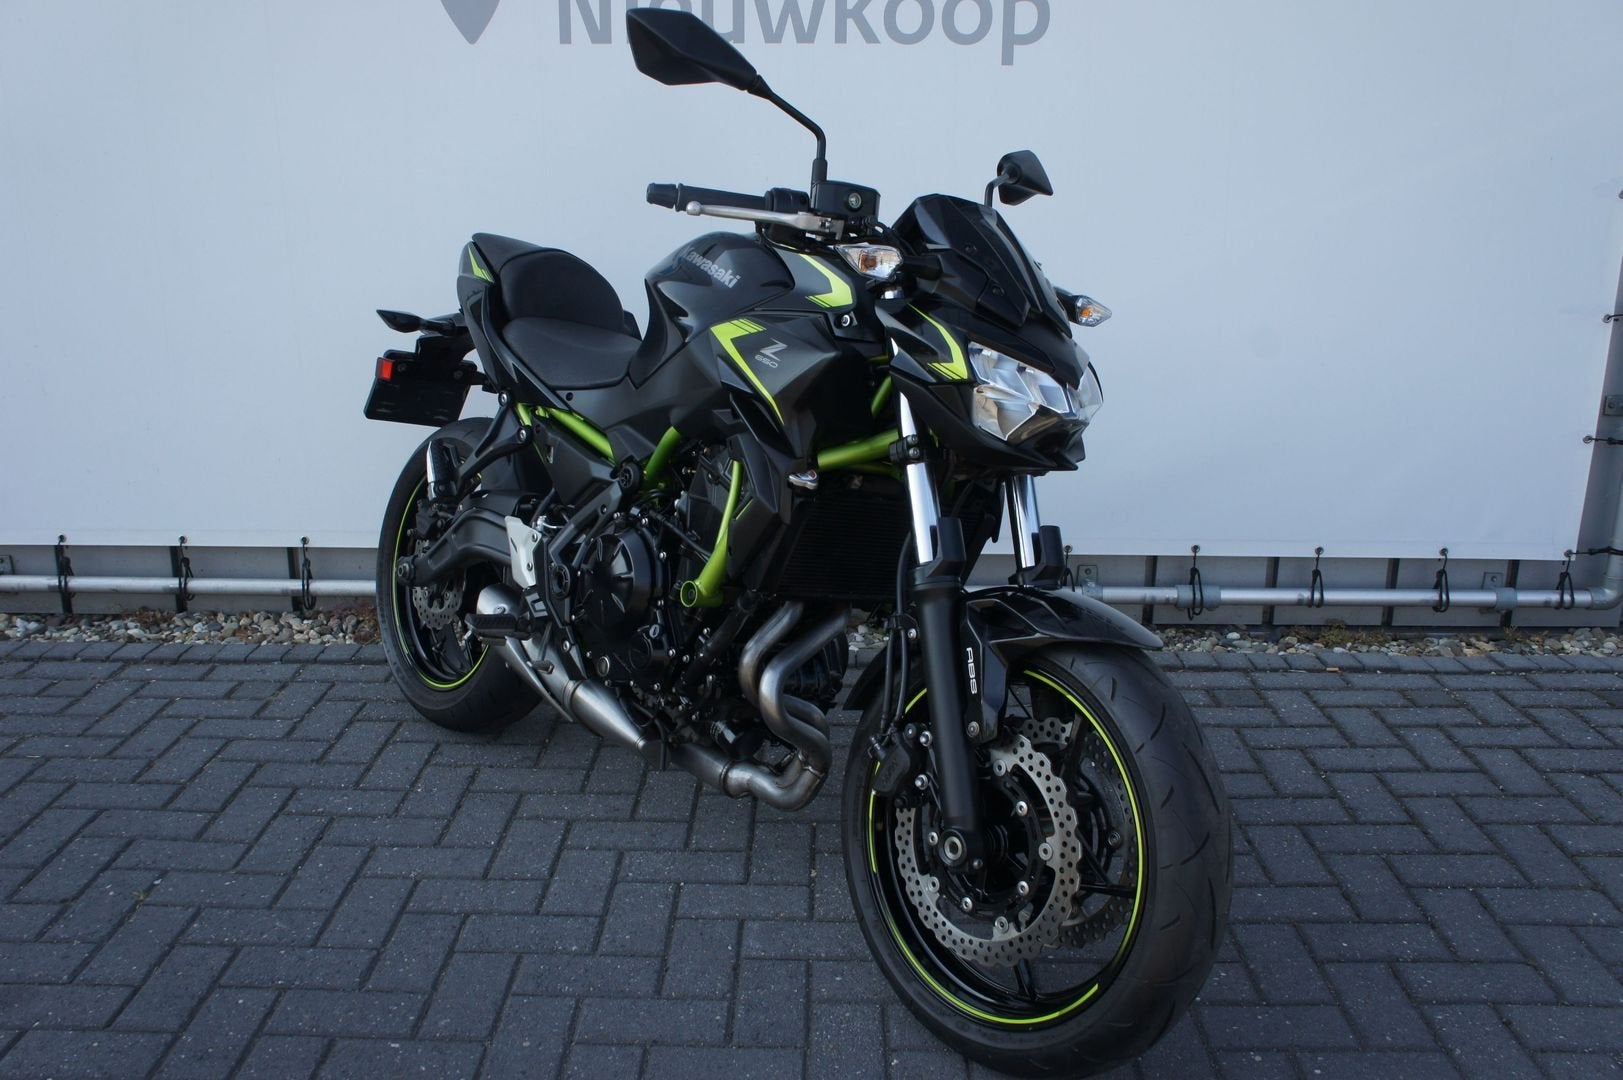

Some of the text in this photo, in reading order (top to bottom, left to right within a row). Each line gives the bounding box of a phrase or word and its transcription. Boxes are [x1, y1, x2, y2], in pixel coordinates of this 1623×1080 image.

[558, 0, 1051, 66] Nuwkoop
[754, 354, 779, 369] 650
[759, 337, 788, 361] Z
[966, 647, 978, 695] ABS
